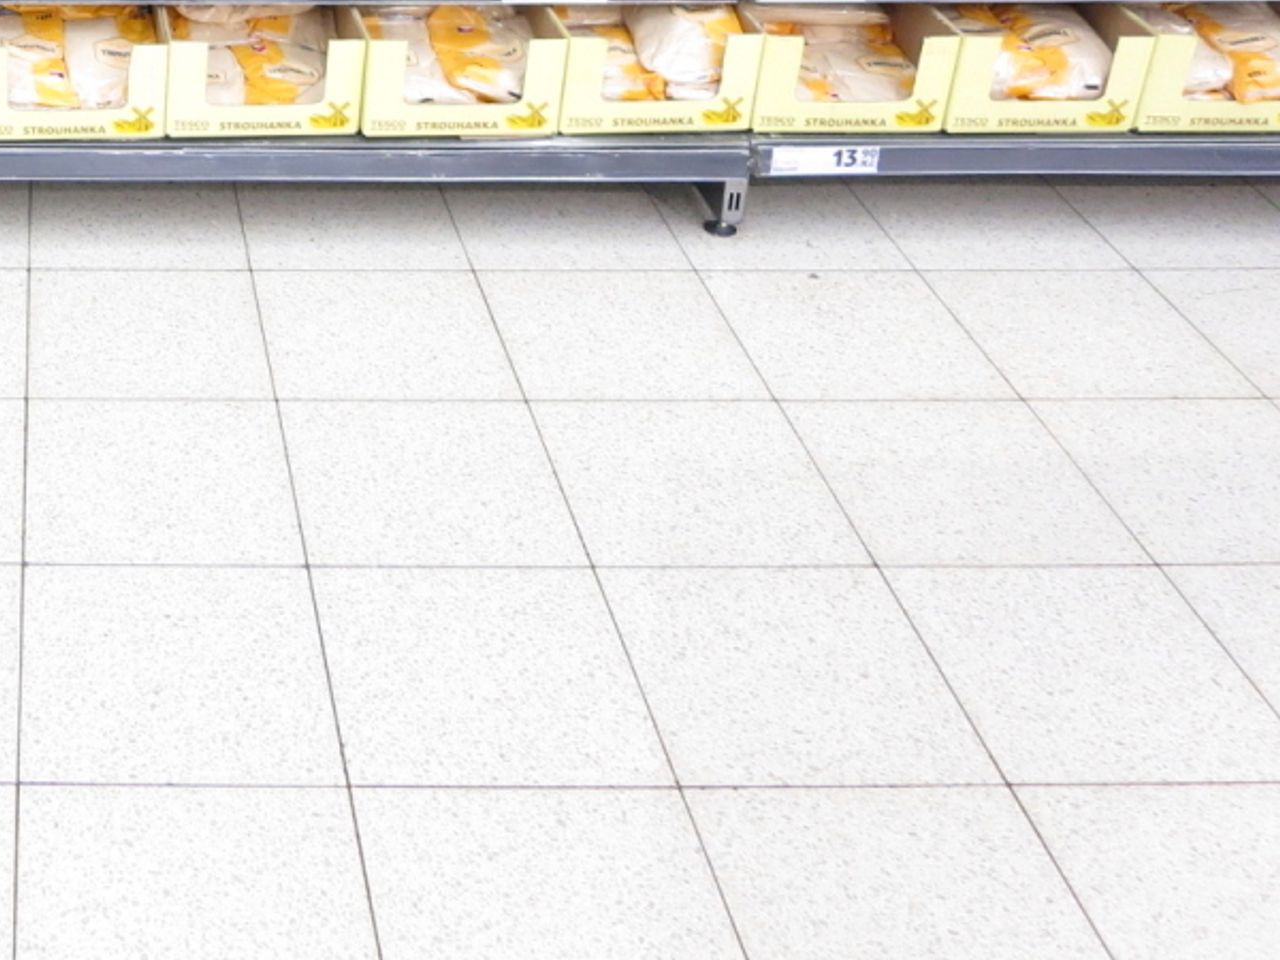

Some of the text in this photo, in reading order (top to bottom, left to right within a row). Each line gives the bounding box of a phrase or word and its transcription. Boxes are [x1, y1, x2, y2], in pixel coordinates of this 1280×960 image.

[219, 121, 302, 131] STROUHANKA
[416, 121, 499, 131] STROUHANKA
[612, 117, 695, 128] STROUHANKA
[804, 117, 887, 127] STROUHANKA
[997, 117, 1077, 127] STROUHANKA
[1190, 117, 1269, 126] STROUHANKA
[23, 125, 106, 136] STROUHANKA
[833, 149, 858, 167] 13
